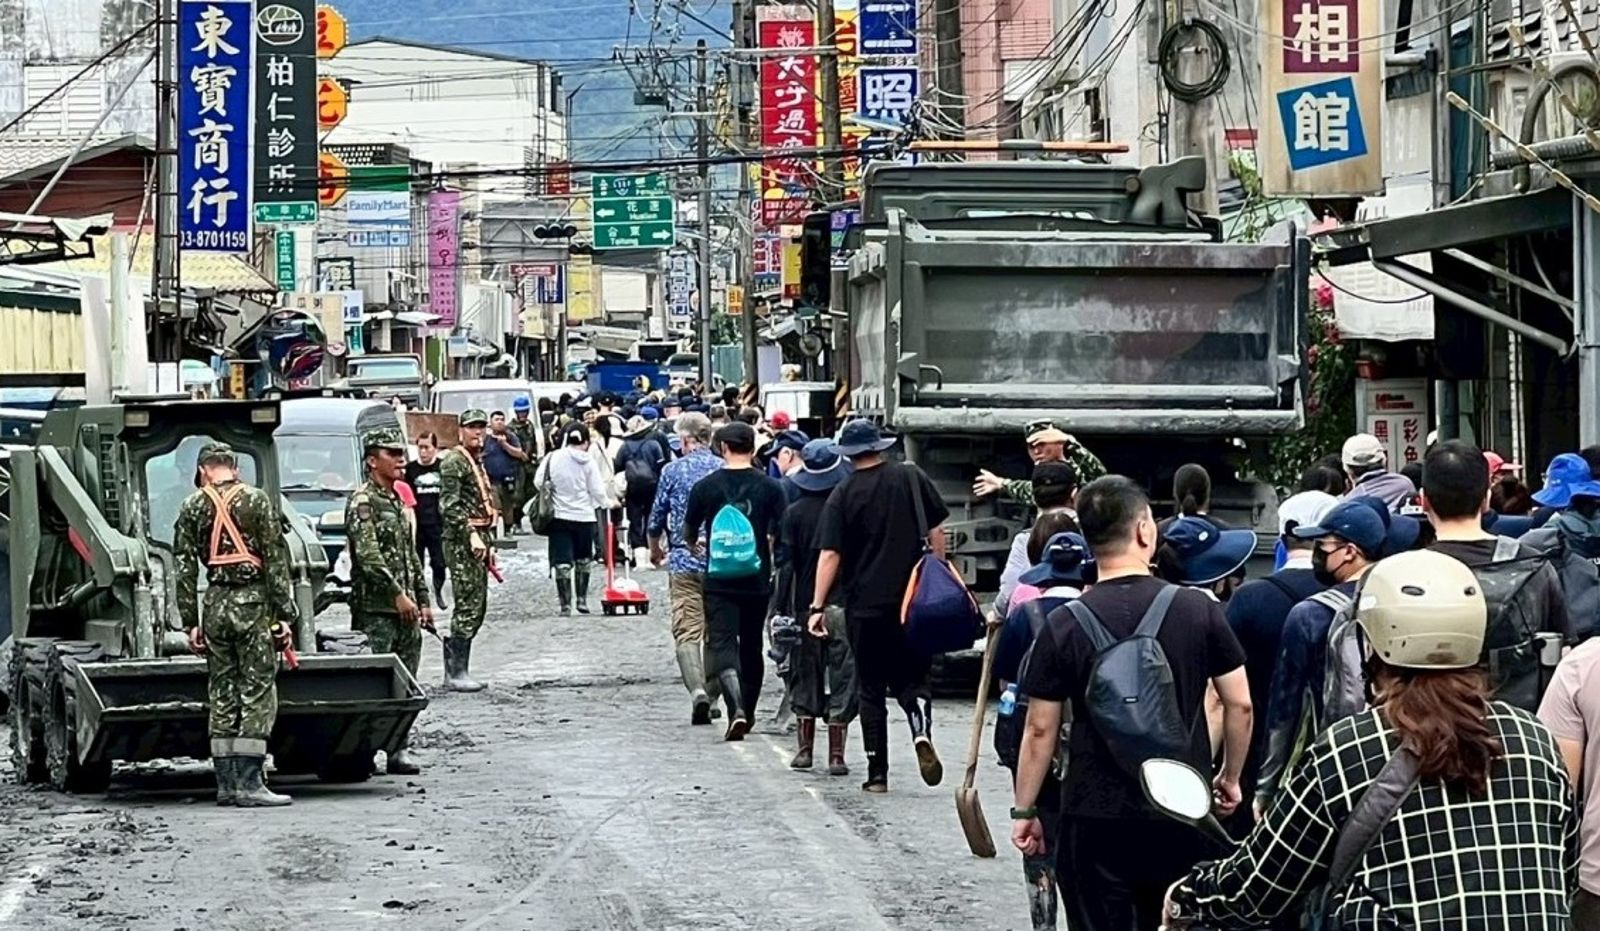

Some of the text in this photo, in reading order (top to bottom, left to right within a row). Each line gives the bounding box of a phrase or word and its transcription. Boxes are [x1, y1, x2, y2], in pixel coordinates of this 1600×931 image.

[186, 5, 241, 228] 東寶商行
[266, 56, 296, 194] 柏仁診所
[1292, 5, 1351, 152] 相館
[349, 201, 408, 211] FamilyMart
[1403, 419, 1419, 463] 彩色
